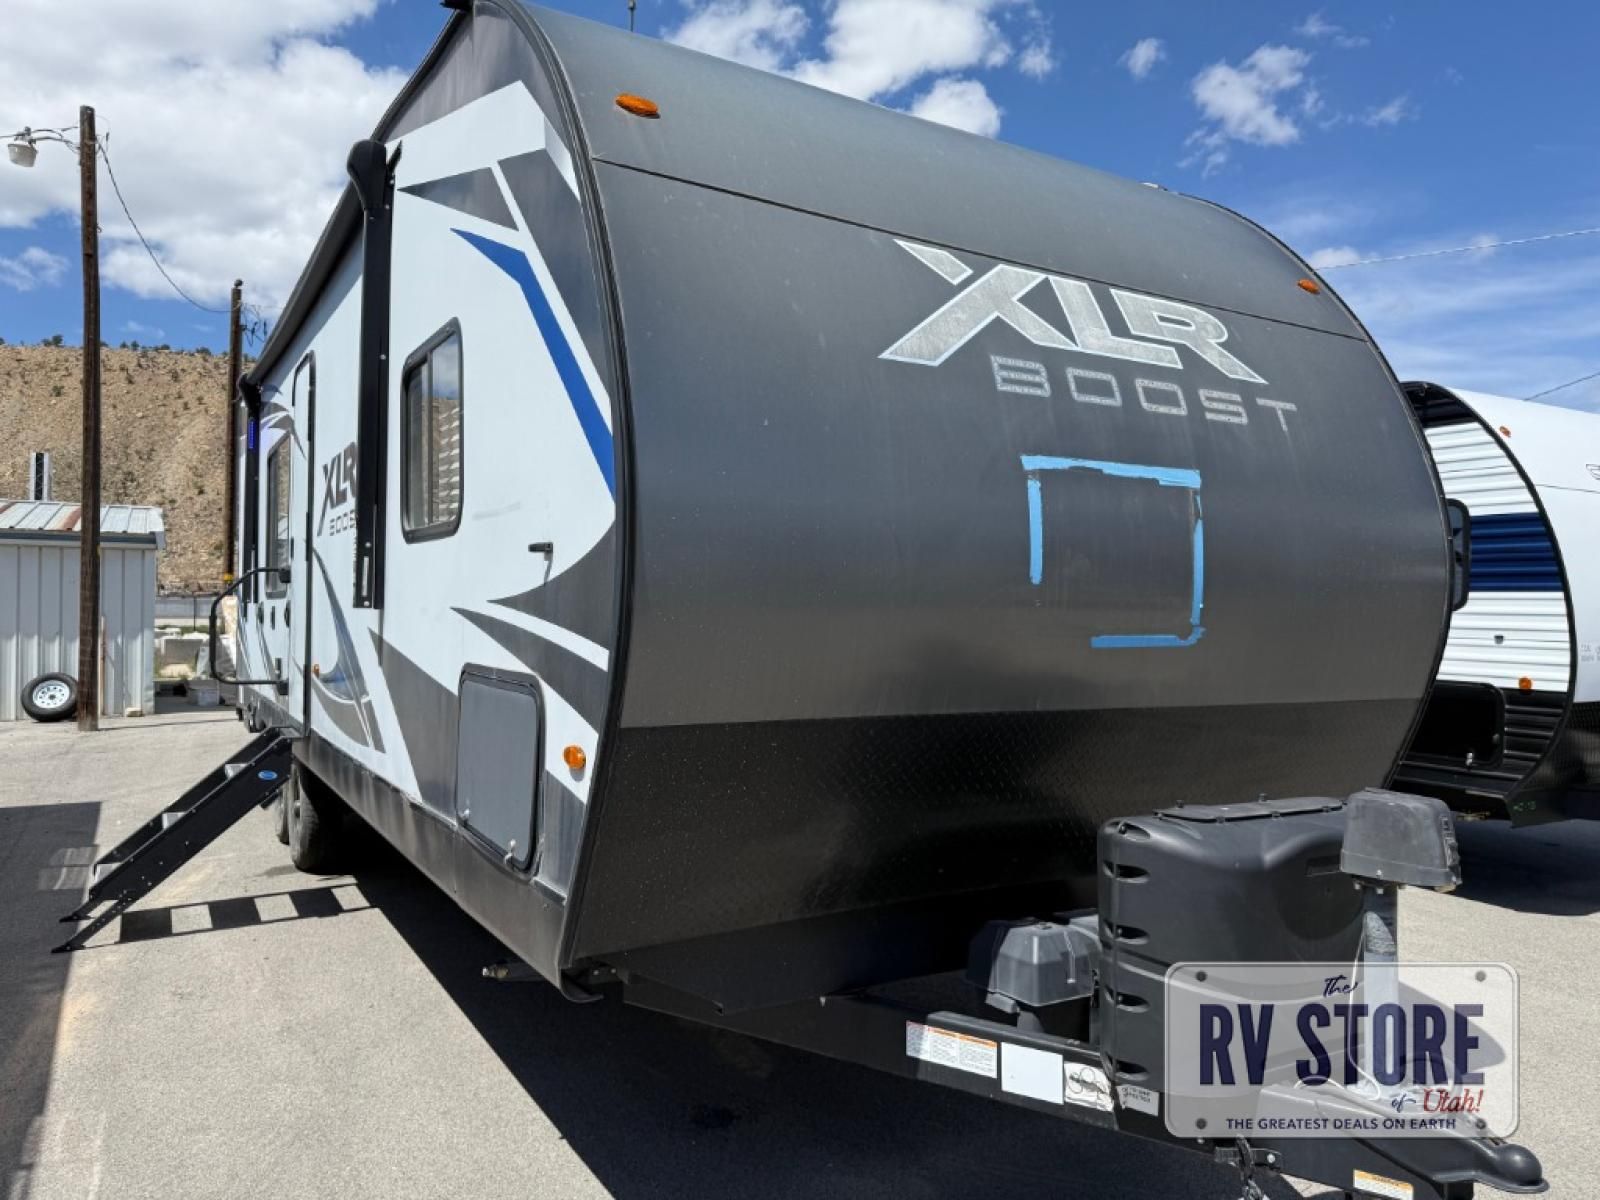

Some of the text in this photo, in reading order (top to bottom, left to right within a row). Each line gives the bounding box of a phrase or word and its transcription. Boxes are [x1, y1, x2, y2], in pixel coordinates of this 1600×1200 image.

[878, 238, 1269, 385] XLR
[989, 354, 1299, 432] BOOST
[316, 441, 358, 537] XLR
[329, 508, 358, 537] BOOS
